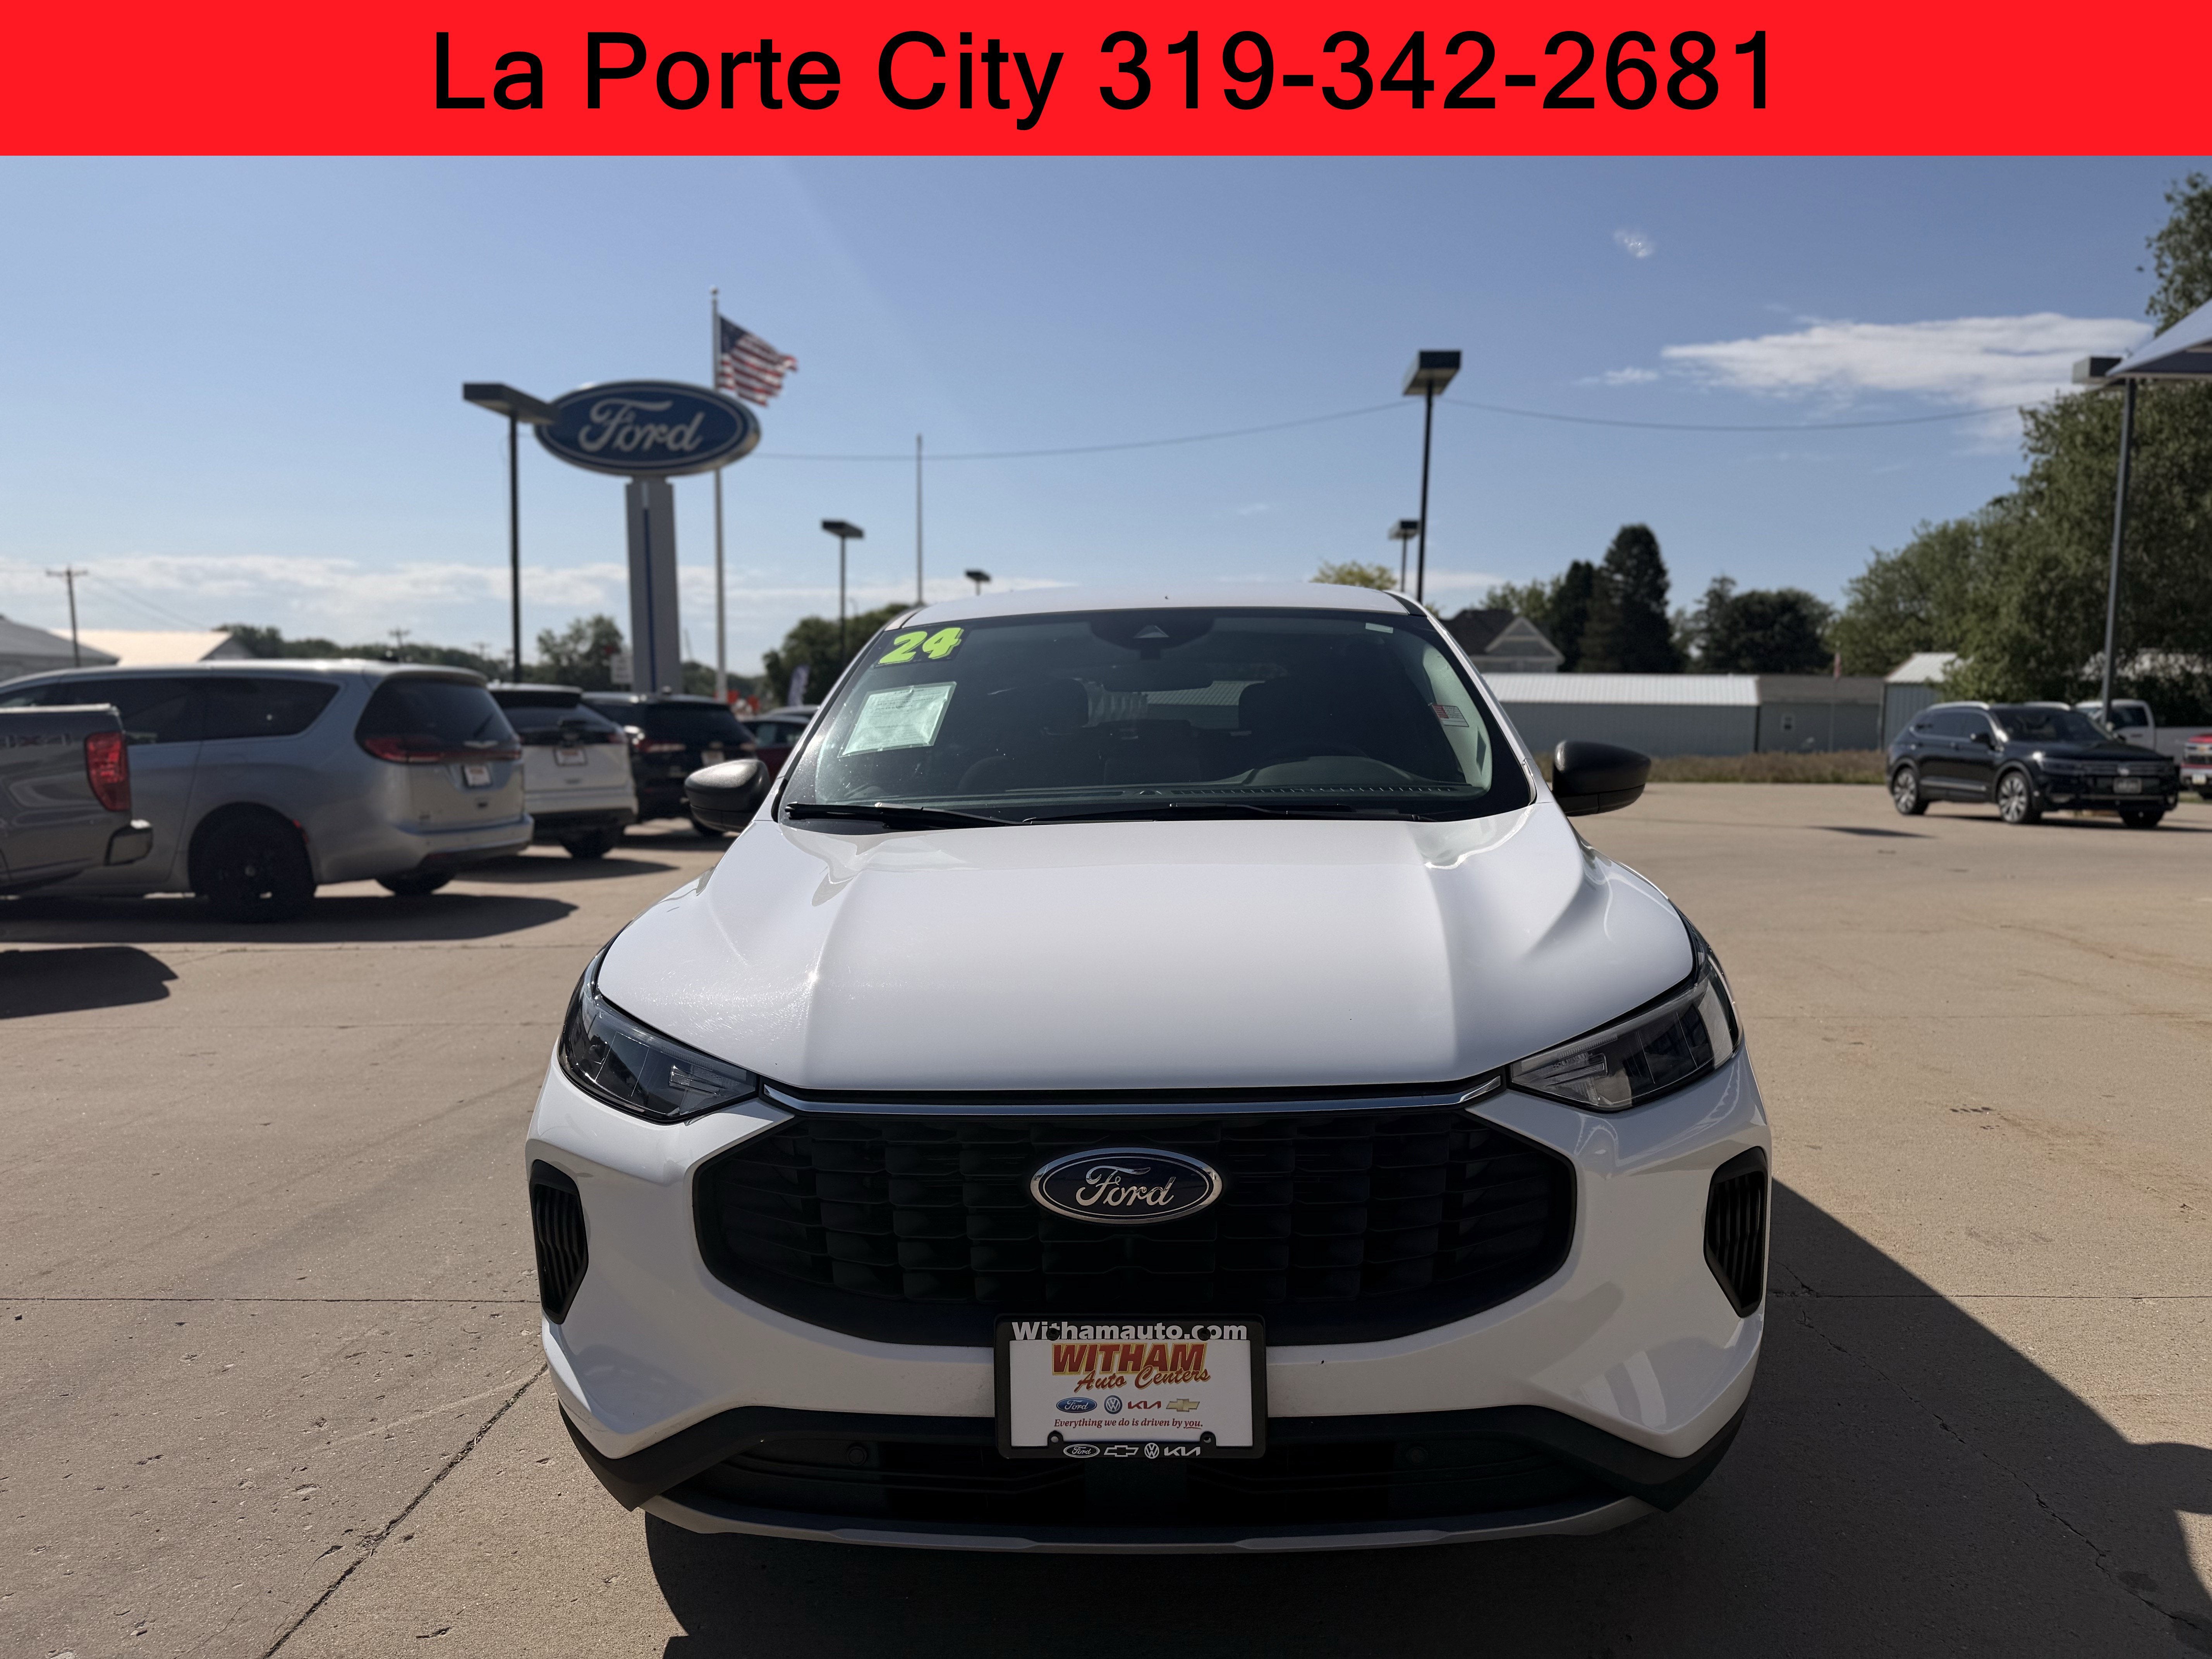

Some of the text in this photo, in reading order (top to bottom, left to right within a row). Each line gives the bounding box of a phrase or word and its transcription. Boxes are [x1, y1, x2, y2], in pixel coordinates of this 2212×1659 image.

[579, 398, 706, 452] Ford
[878, 627, 964, 664] 24
[1076, 1165, 1176, 1206] Ford
[1052, 1343, 1207, 1374] WITHAM
[1074, 1365, 1211, 1393] Auto Centers
[1065, 1400, 1089, 1411] Ford
[1054, 1419, 1103, 1429] Everything
[1118, 1418, 1129, 1427] do
[1132, 1418, 1139, 1427] is
[1140, 1418, 1170, 1427] driven
[1172, 1418, 1183, 1429] by
[1183, 1420, 1203, 1429] you.
